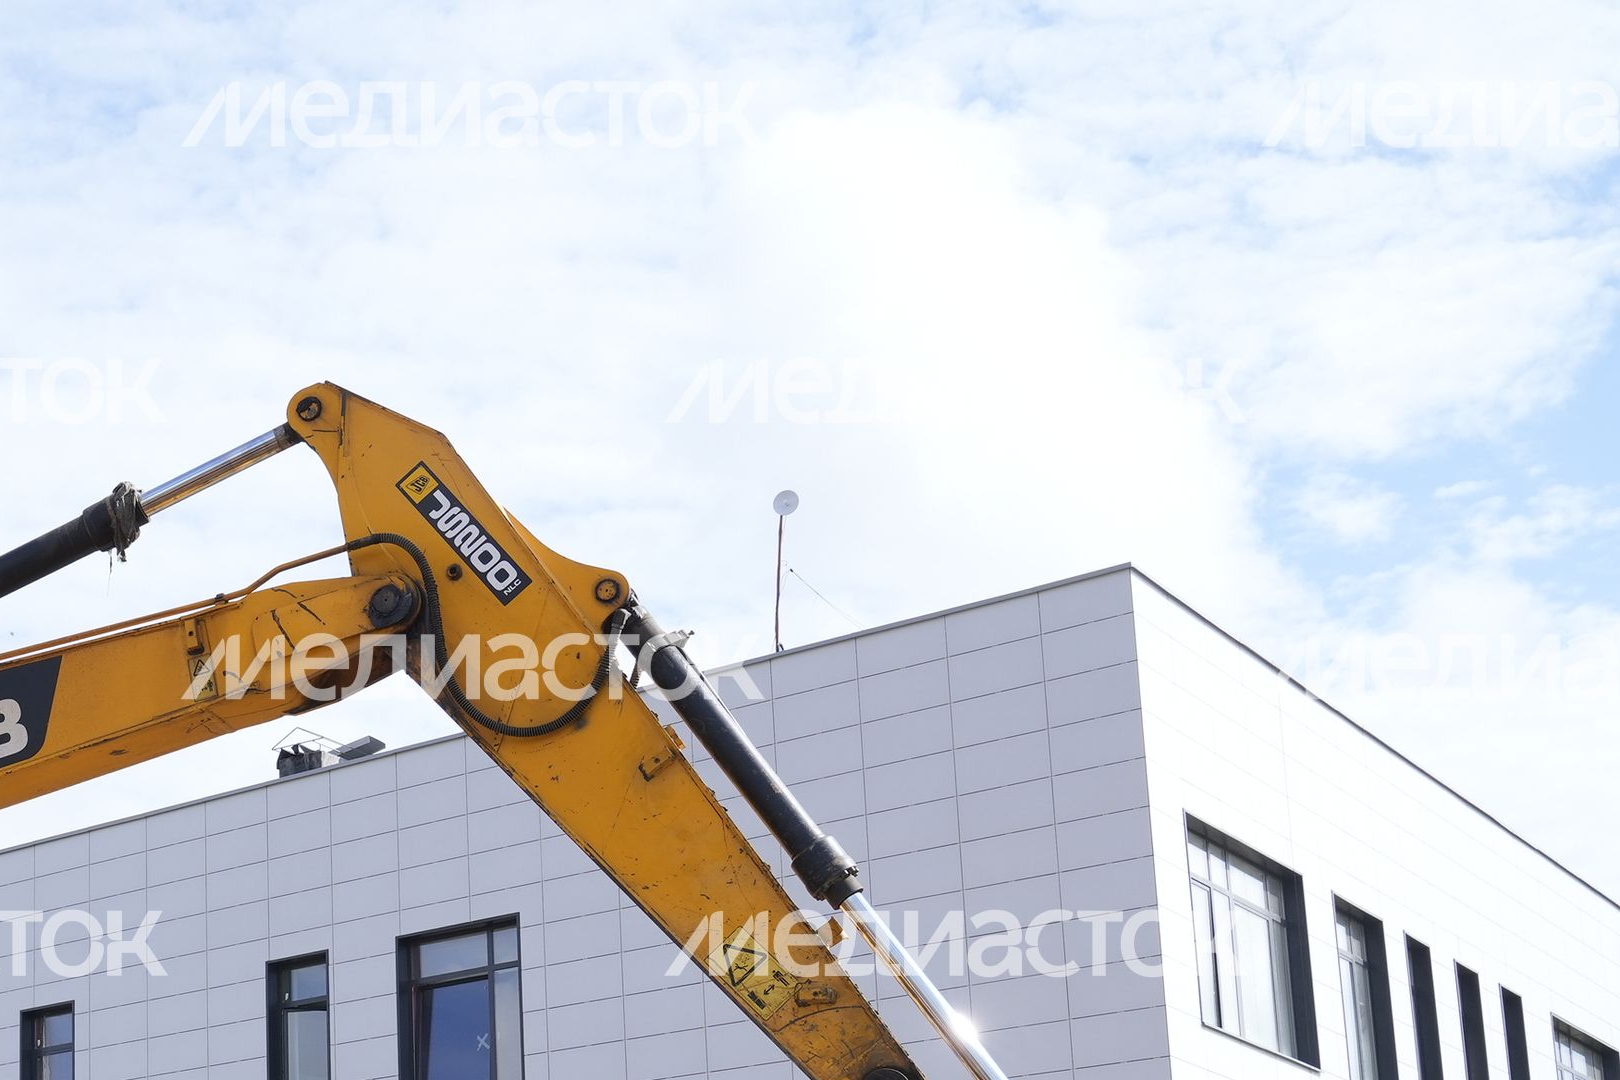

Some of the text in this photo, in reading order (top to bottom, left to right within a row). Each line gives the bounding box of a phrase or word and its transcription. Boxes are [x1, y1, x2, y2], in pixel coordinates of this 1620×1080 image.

[410, 476, 428, 493] JCB
[428, 489, 518, 591] JS200
[503, 579, 522, 596] NLC
